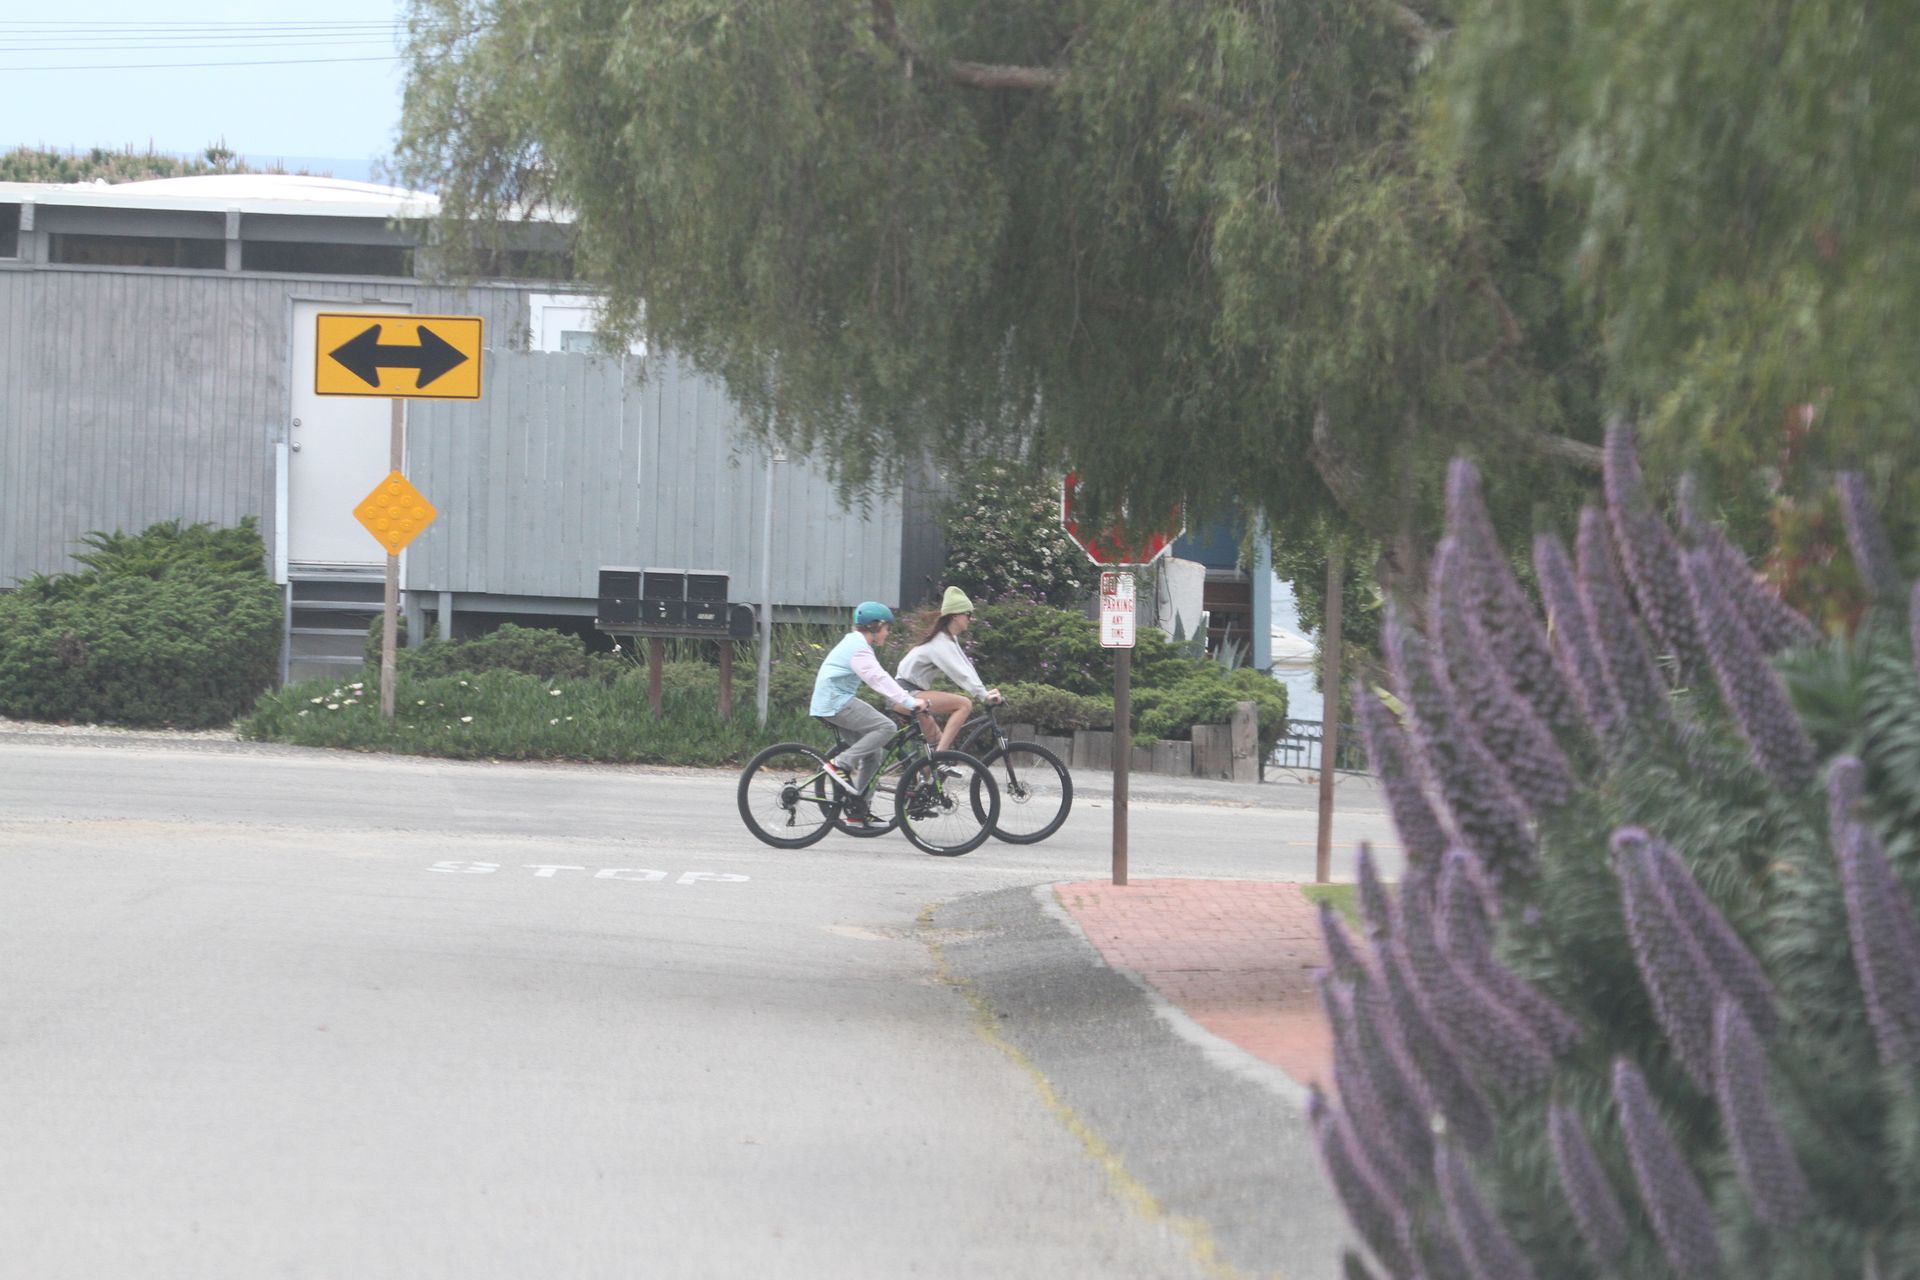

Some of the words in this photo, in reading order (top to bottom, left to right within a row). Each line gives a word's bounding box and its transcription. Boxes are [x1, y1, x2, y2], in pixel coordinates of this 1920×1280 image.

[1103, 599, 1133, 612] PARKING
[1112, 615, 1124, 625] ANY
[1111, 628, 1125, 639] TIME
[425, 861, 751, 885] STOP
